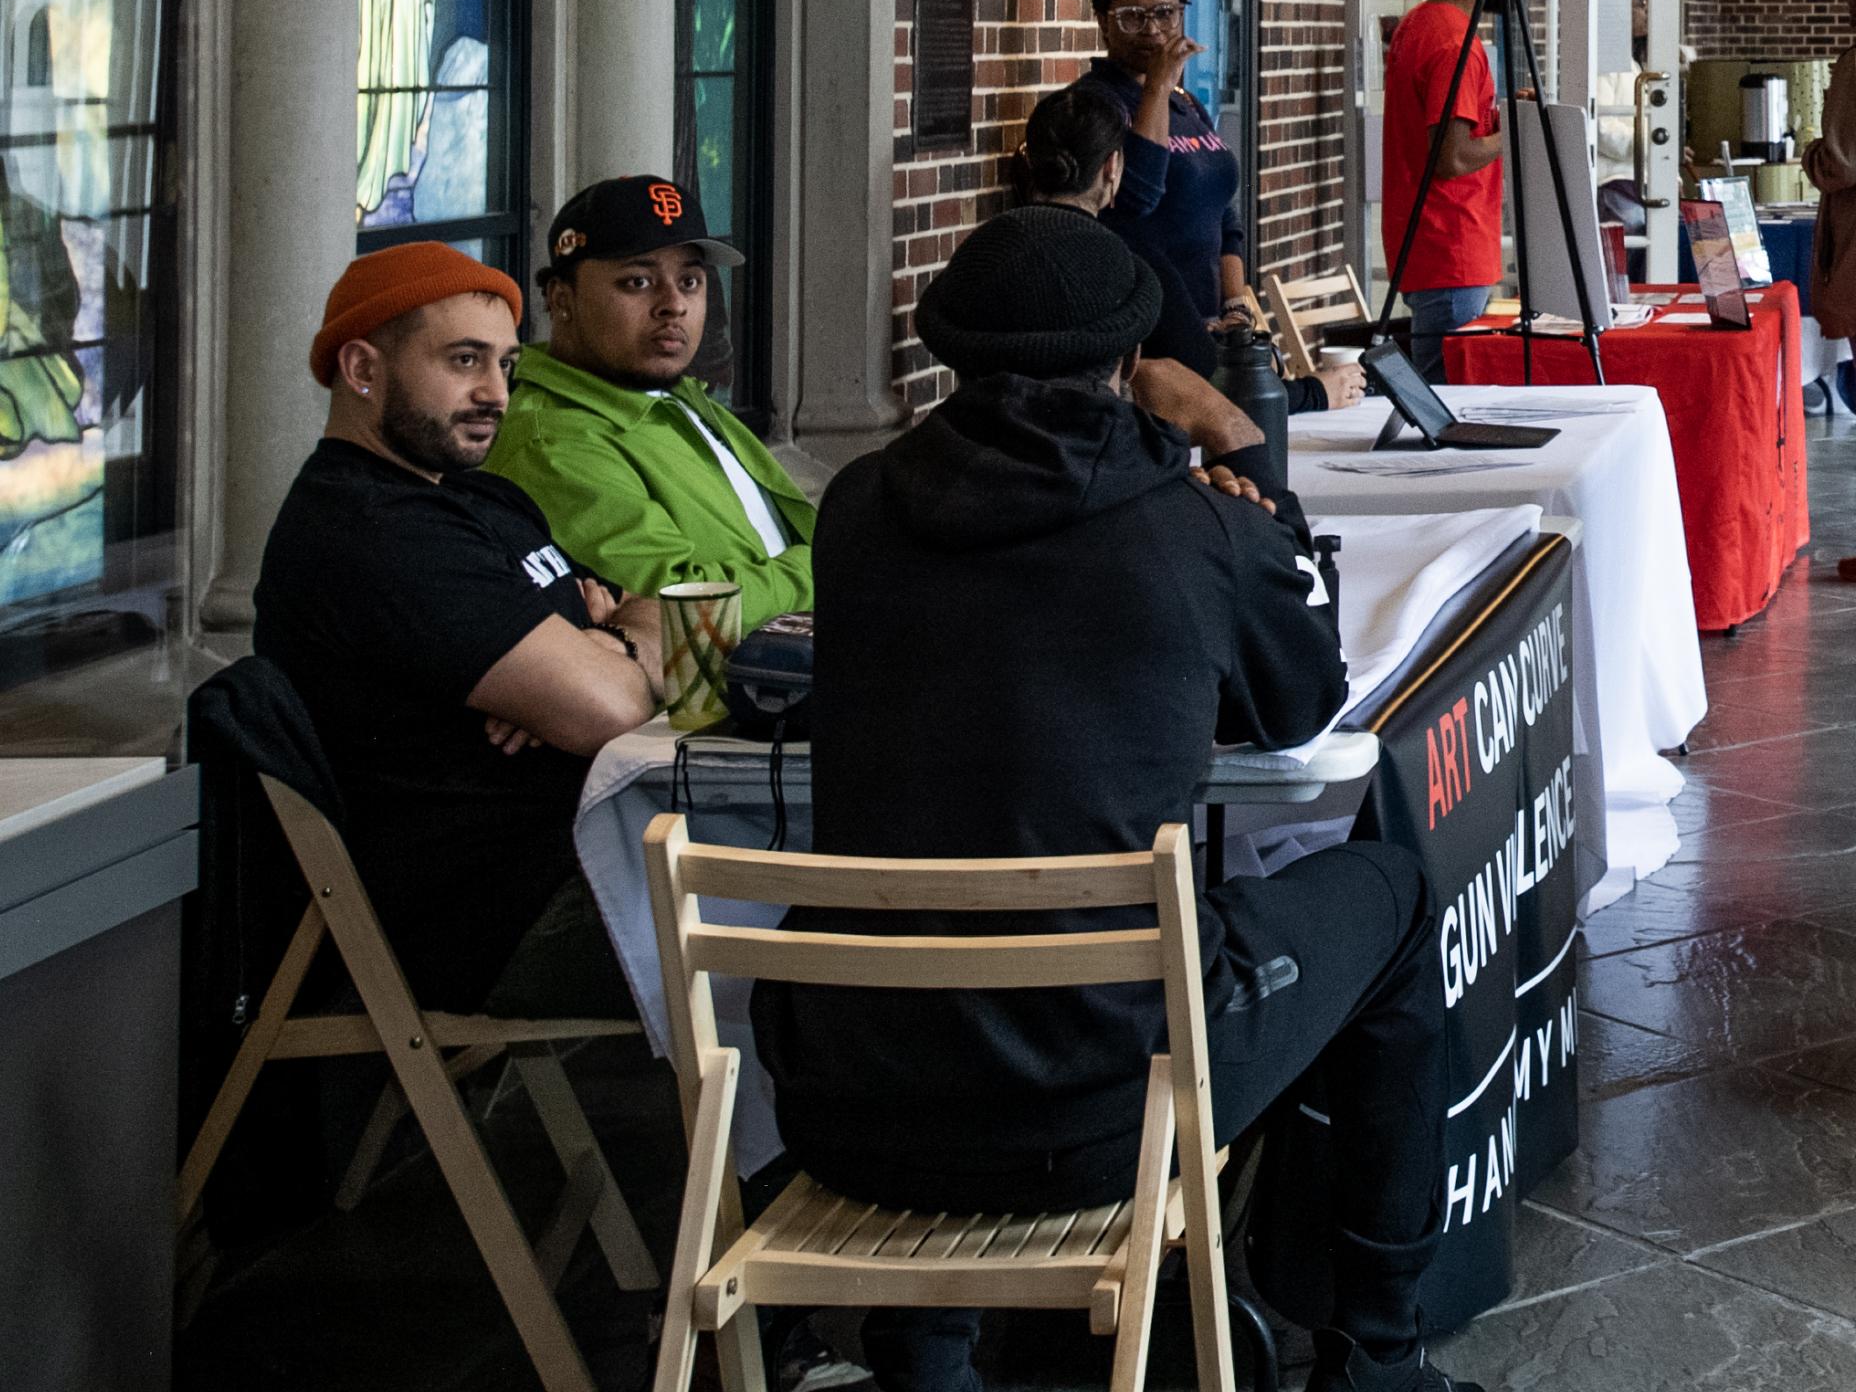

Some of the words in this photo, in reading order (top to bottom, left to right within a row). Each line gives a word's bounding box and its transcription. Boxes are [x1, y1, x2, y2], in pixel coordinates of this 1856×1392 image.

[648, 183, 682, 226] SF
[1427, 696, 1471, 832] ART
[1474, 654, 1518, 774] CAN
[1519, 602, 1568, 726] CURVE
[1441, 861, 1498, 1008] GUN
[1496, 755, 1576, 936] VILENCE
